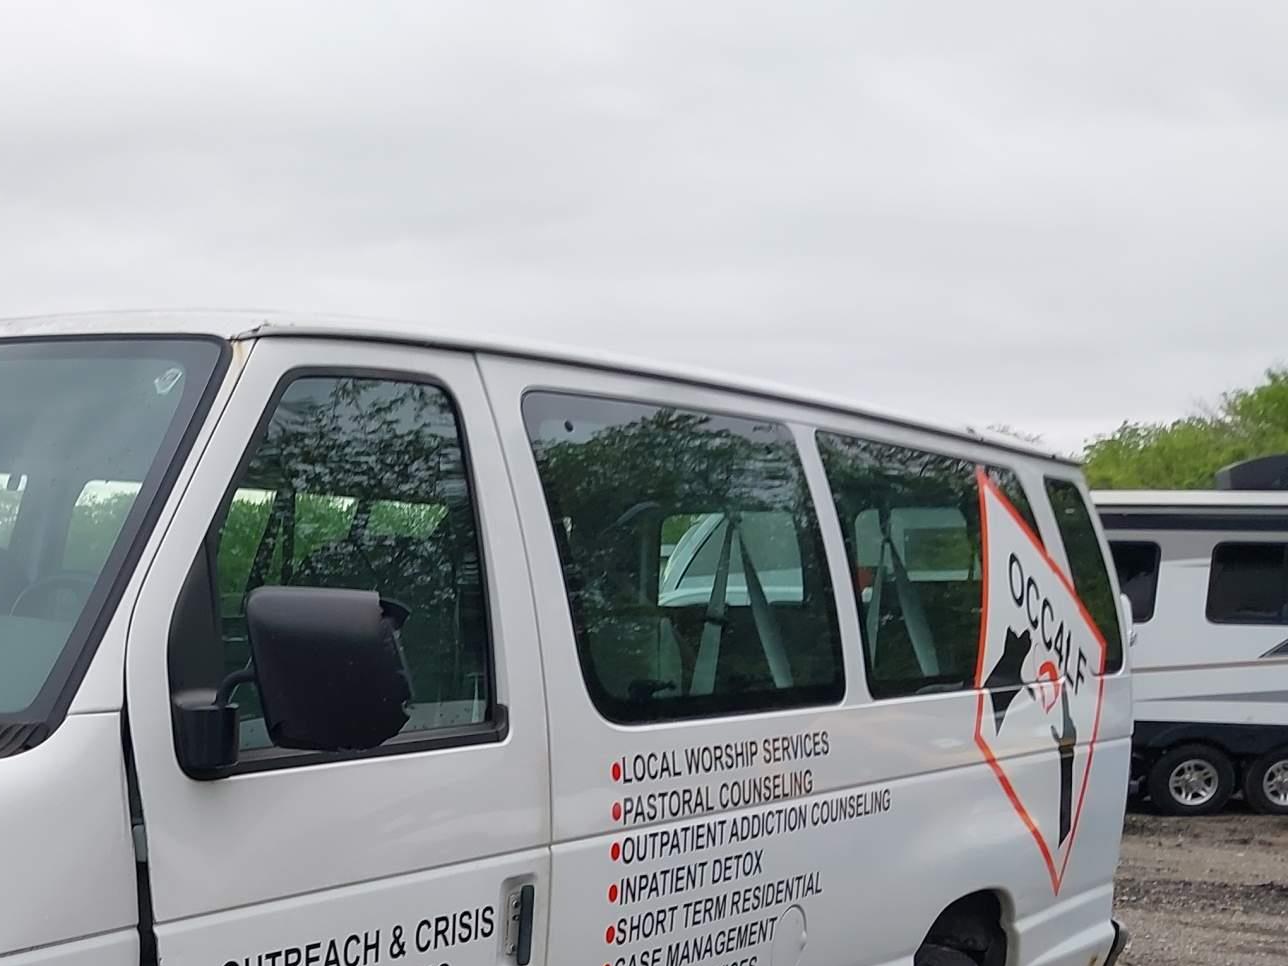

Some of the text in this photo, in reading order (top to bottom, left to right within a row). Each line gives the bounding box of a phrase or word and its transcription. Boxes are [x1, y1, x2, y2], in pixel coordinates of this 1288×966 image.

[622, 731, 830, 784] LOCAL WORSHIP SERVICES
[623, 769, 813, 825] PASTORAL COUNSELING
[621, 788, 891, 865] OUTPATIENT ADDICTION COUNSELING
[619, 849, 764, 905] INPATIENT DETOX
[390, 925, 406, 959] &
[415, 906, 495, 952] CRISIS
[615, 871, 823, 946] SHORT TERM RESIDENTIAL
